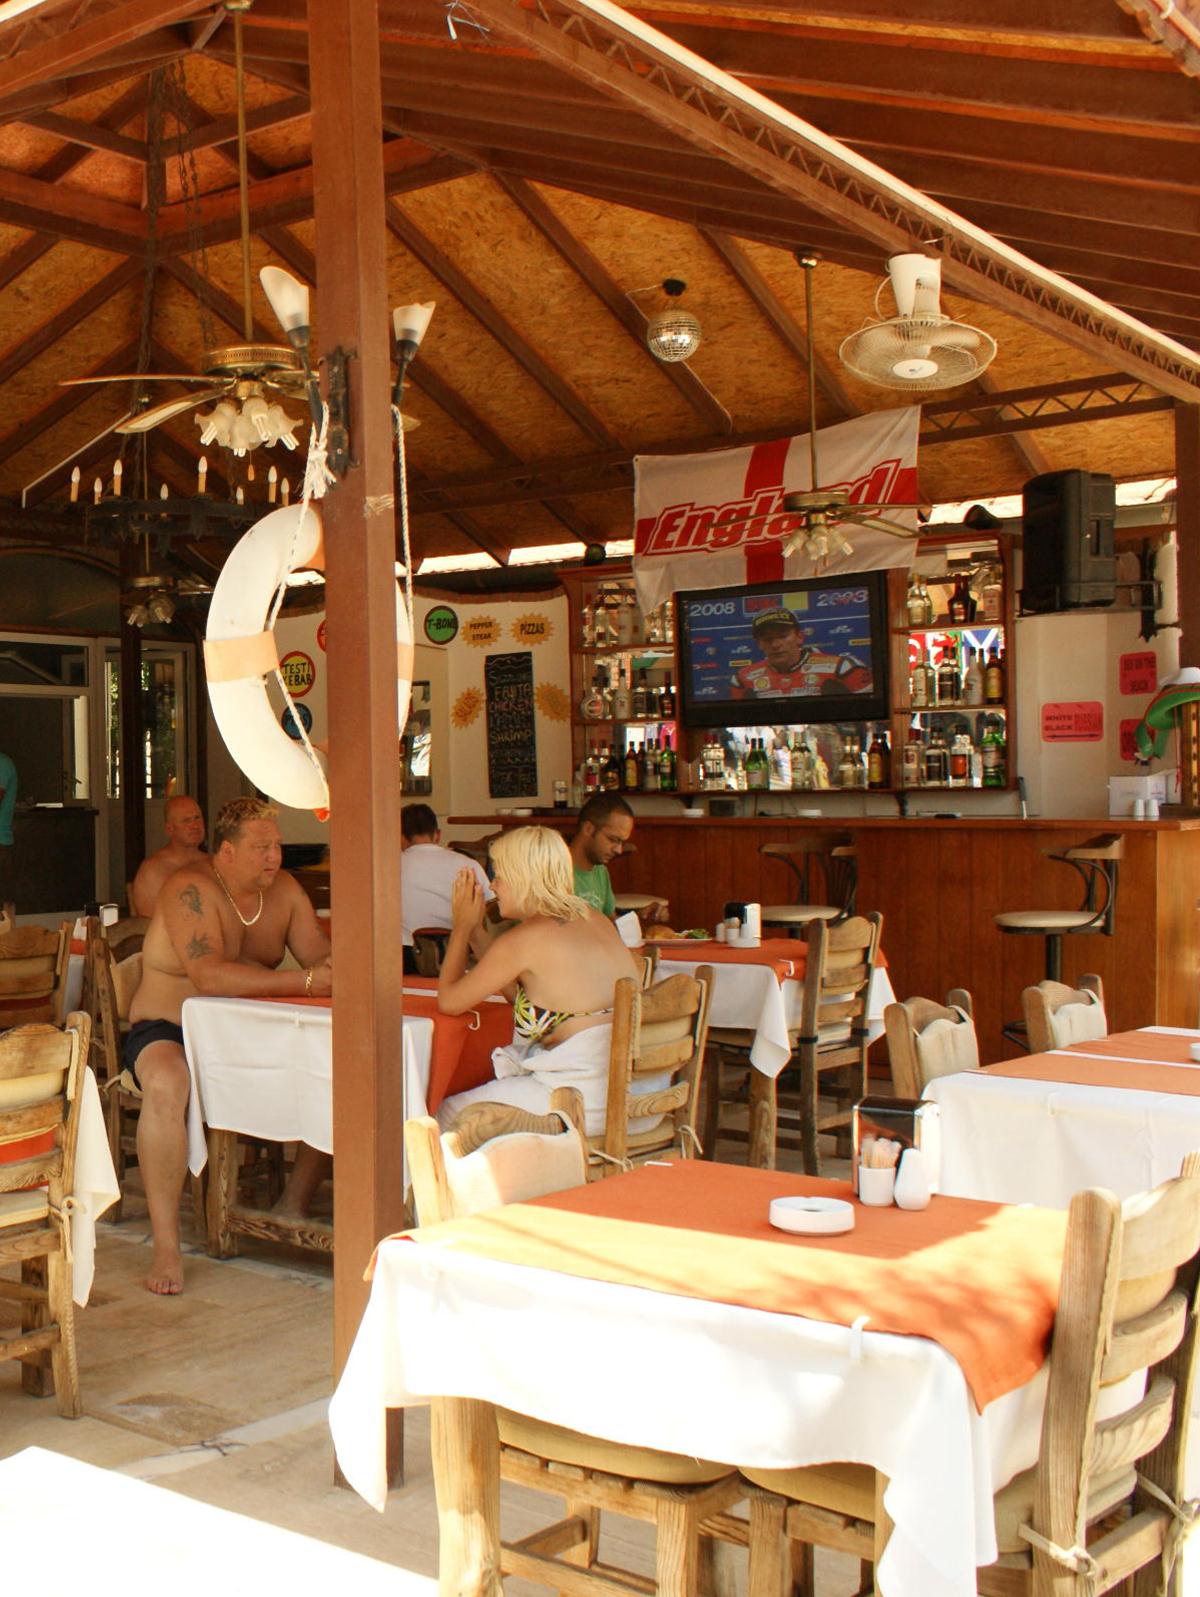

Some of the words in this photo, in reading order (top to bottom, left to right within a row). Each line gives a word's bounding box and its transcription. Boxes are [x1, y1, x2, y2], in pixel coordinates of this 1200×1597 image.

[644, 459, 901, 554] Englad
[689, 601, 736, 617] 2008
[469, 622, 493, 630] PEPPER
[472, 633, 492, 641] STEAK
[283, 674, 312, 686] KEBAB
